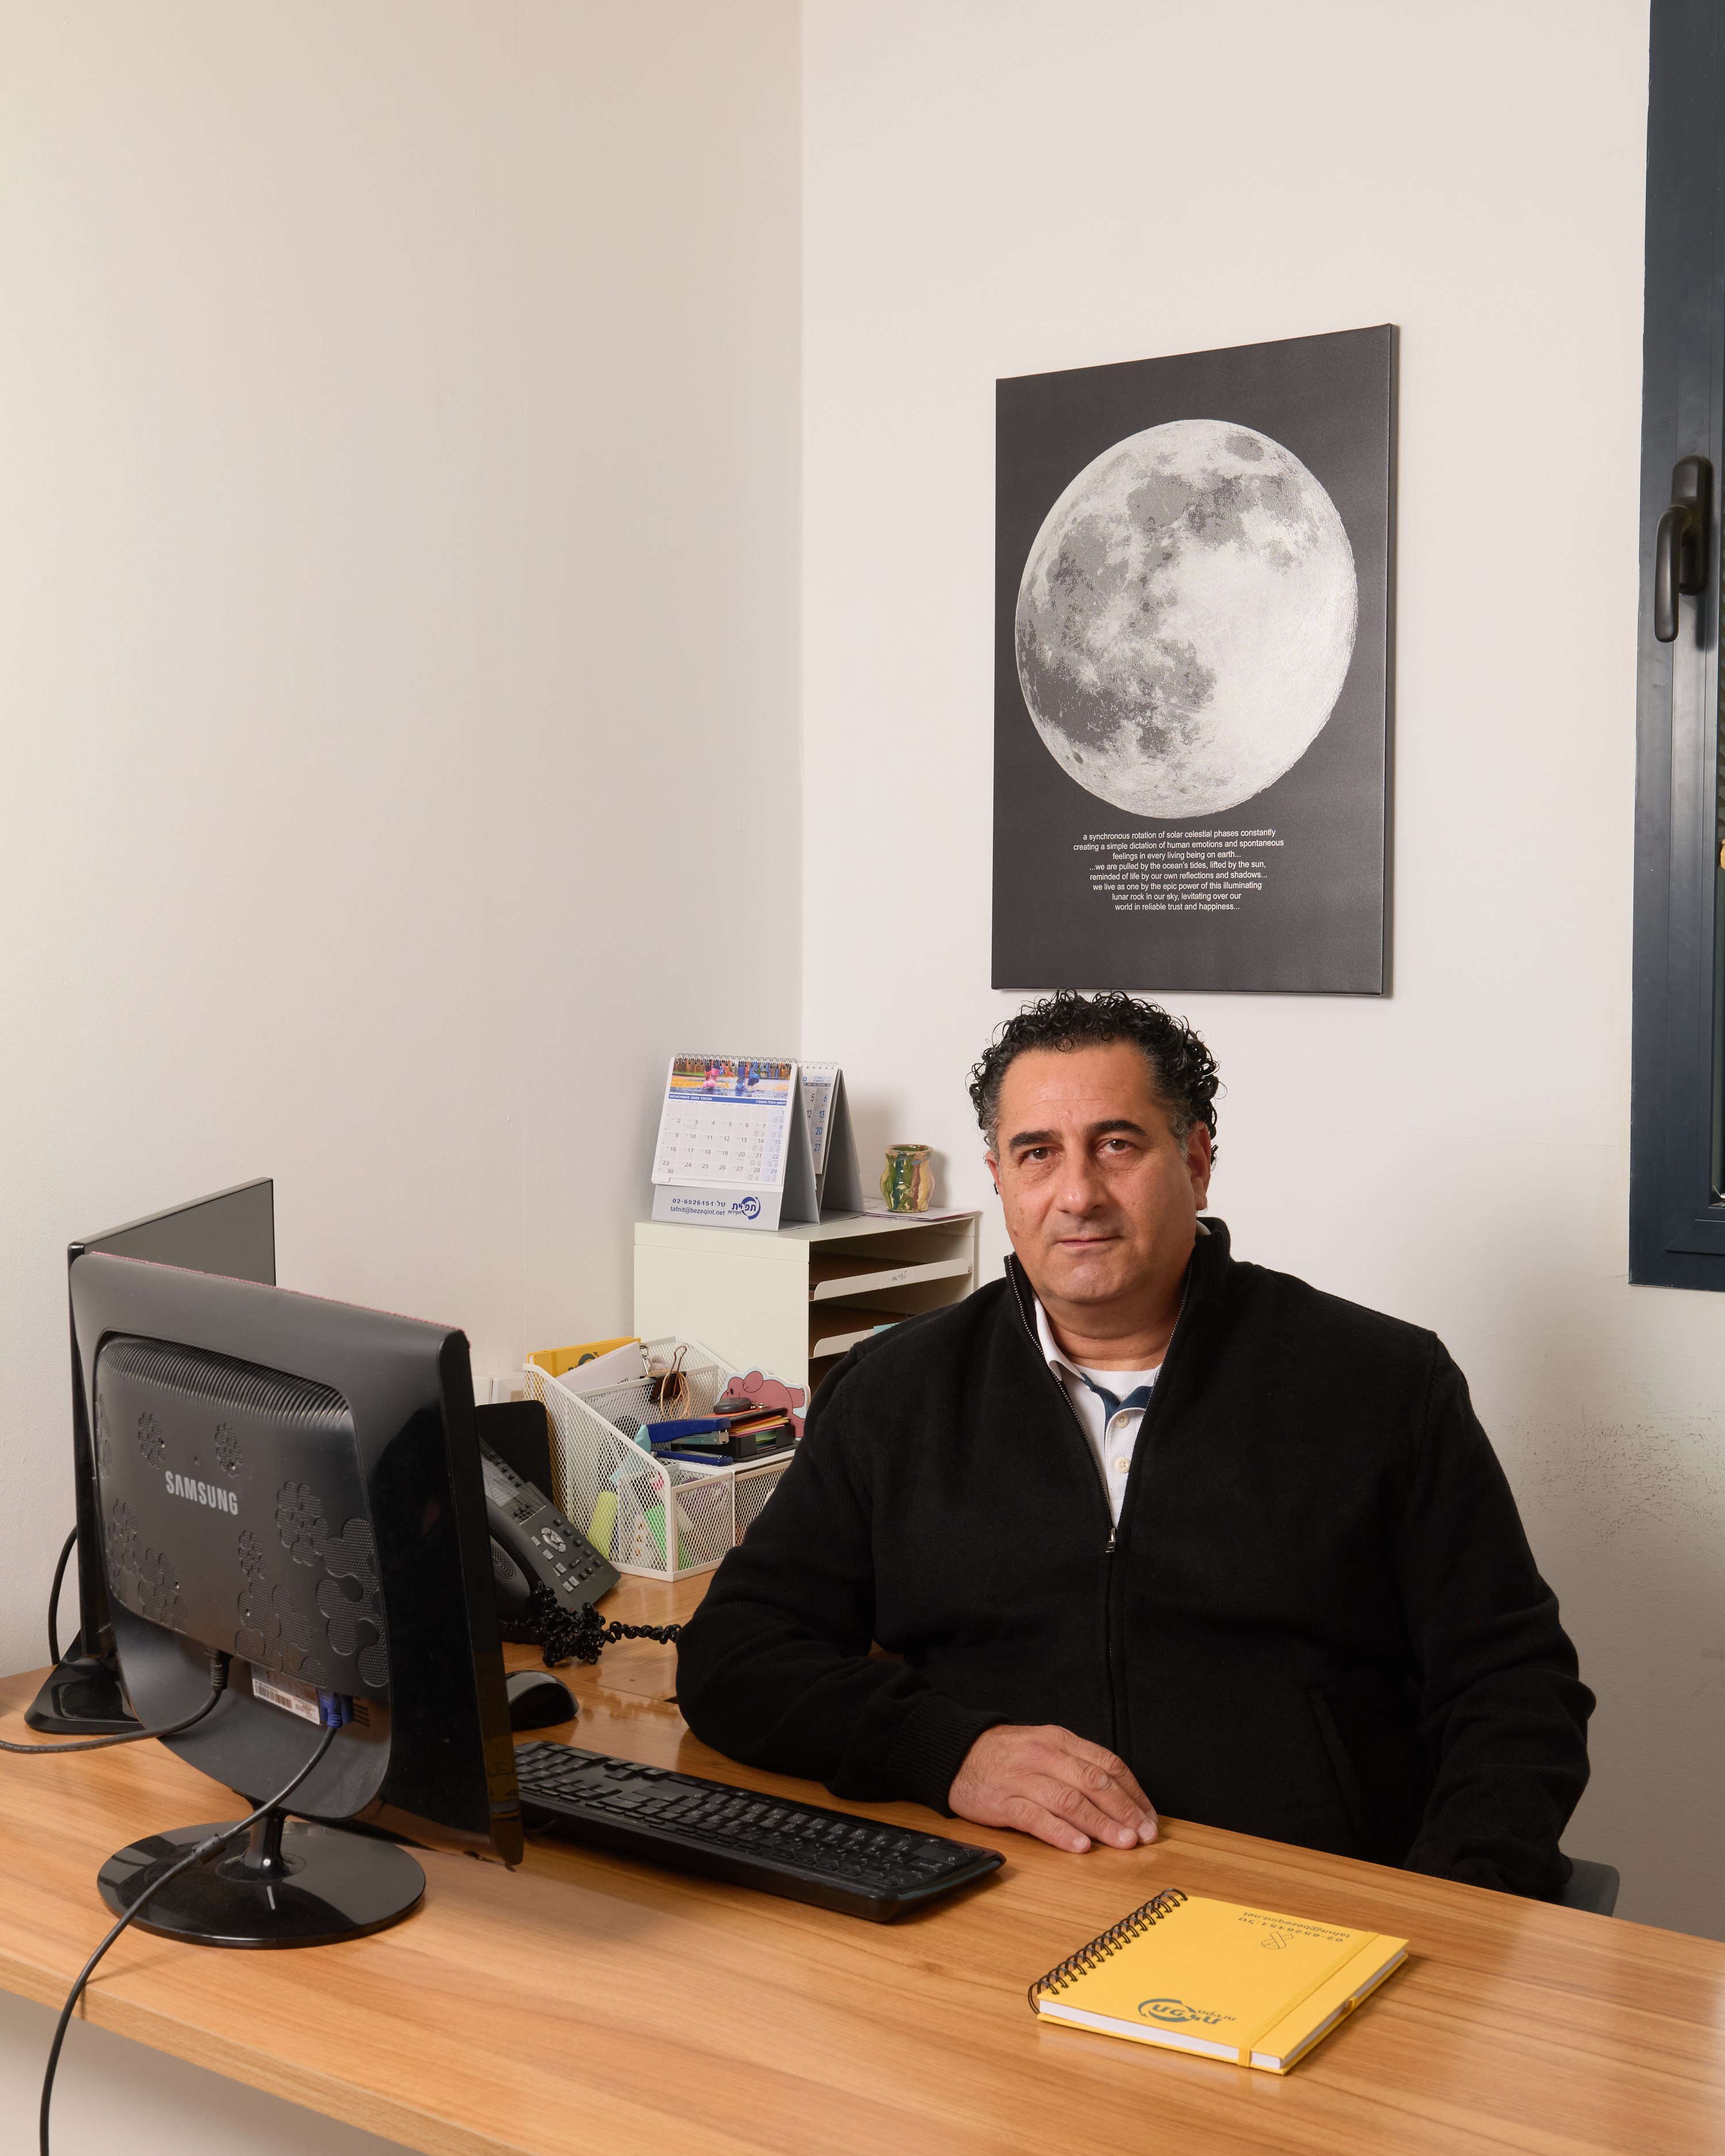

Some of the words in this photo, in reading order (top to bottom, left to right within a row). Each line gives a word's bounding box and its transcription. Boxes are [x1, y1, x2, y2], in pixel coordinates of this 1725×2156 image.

[1088, 833, 1130, 842] synchronous
[1184, 830, 1212, 838] celestial
[1213, 830, 1239, 839] phases
[1240, 828, 1276, 838] constantly
[1073, 843, 1099, 851] creating
[1106, 842, 1128, 851] simple
[1191, 840, 1223, 848] emotions
[1224, 839, 1237, 847] and
[1239, 839, 1285, 849] spontaneous
[1112, 852, 1138, 861] feelings
[1167, 851, 1184, 860] living
[1186, 851, 1205, 860] being
[1118, 862, 1138, 872] pulled
[1140, 862, 1149, 871] by
[1162, 861, 1189, 869] ocean's
[1189, 861, 1208, 869] tides,
[1228, 861, 1237, 870] by
[1141, 872, 1149, 881] by
[1140, 883, 1149, 892] by
[1163, 882, 1177, 891] epic
[1178, 883, 1199, 891] power
[1209, 881, 1222, 889] this
[1223, 881, 1262, 891] illuminating
[1166, 892, 1179, 901] sky,
[1181, 892, 1212, 901] levitating
[1198, 903, 1240, 912] happiness...
[811, 1094, 814, 1102] 5
[819, 1110, 825, 1118] 13
[815, 1127, 822, 1135] 20
[814, 1144, 821, 1152] 27
[670, 1206, 725, 1215] tafnit@bezeqint.net
[165, 1470, 239, 1516] SAMSUNG
[1242, 1912, 1351, 1939] tafnit@bezeqint.net
